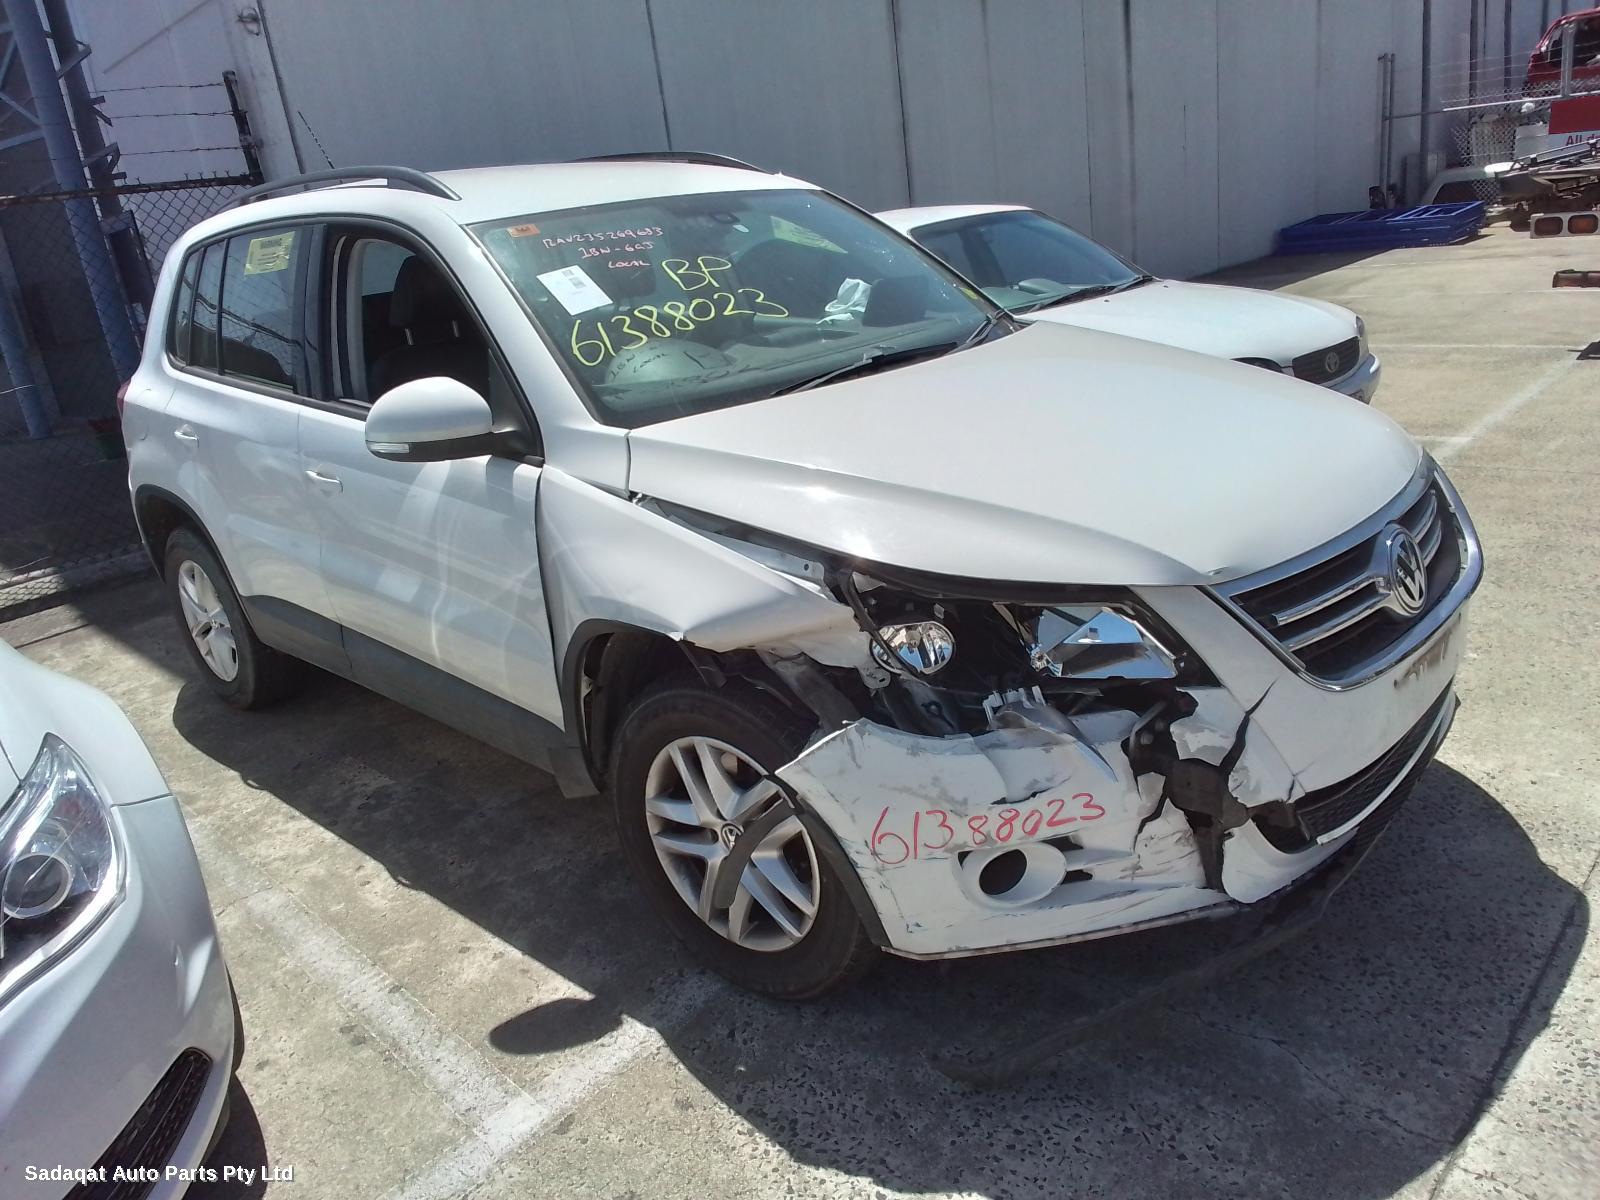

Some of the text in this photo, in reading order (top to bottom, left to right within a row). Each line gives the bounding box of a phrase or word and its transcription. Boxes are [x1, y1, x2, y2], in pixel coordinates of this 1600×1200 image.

[608, 260, 651, 268] LOCAL
[661, 256, 732, 291] BP
[570, 288, 789, 366] 61388023
[870, 792, 1106, 865] 61388023
